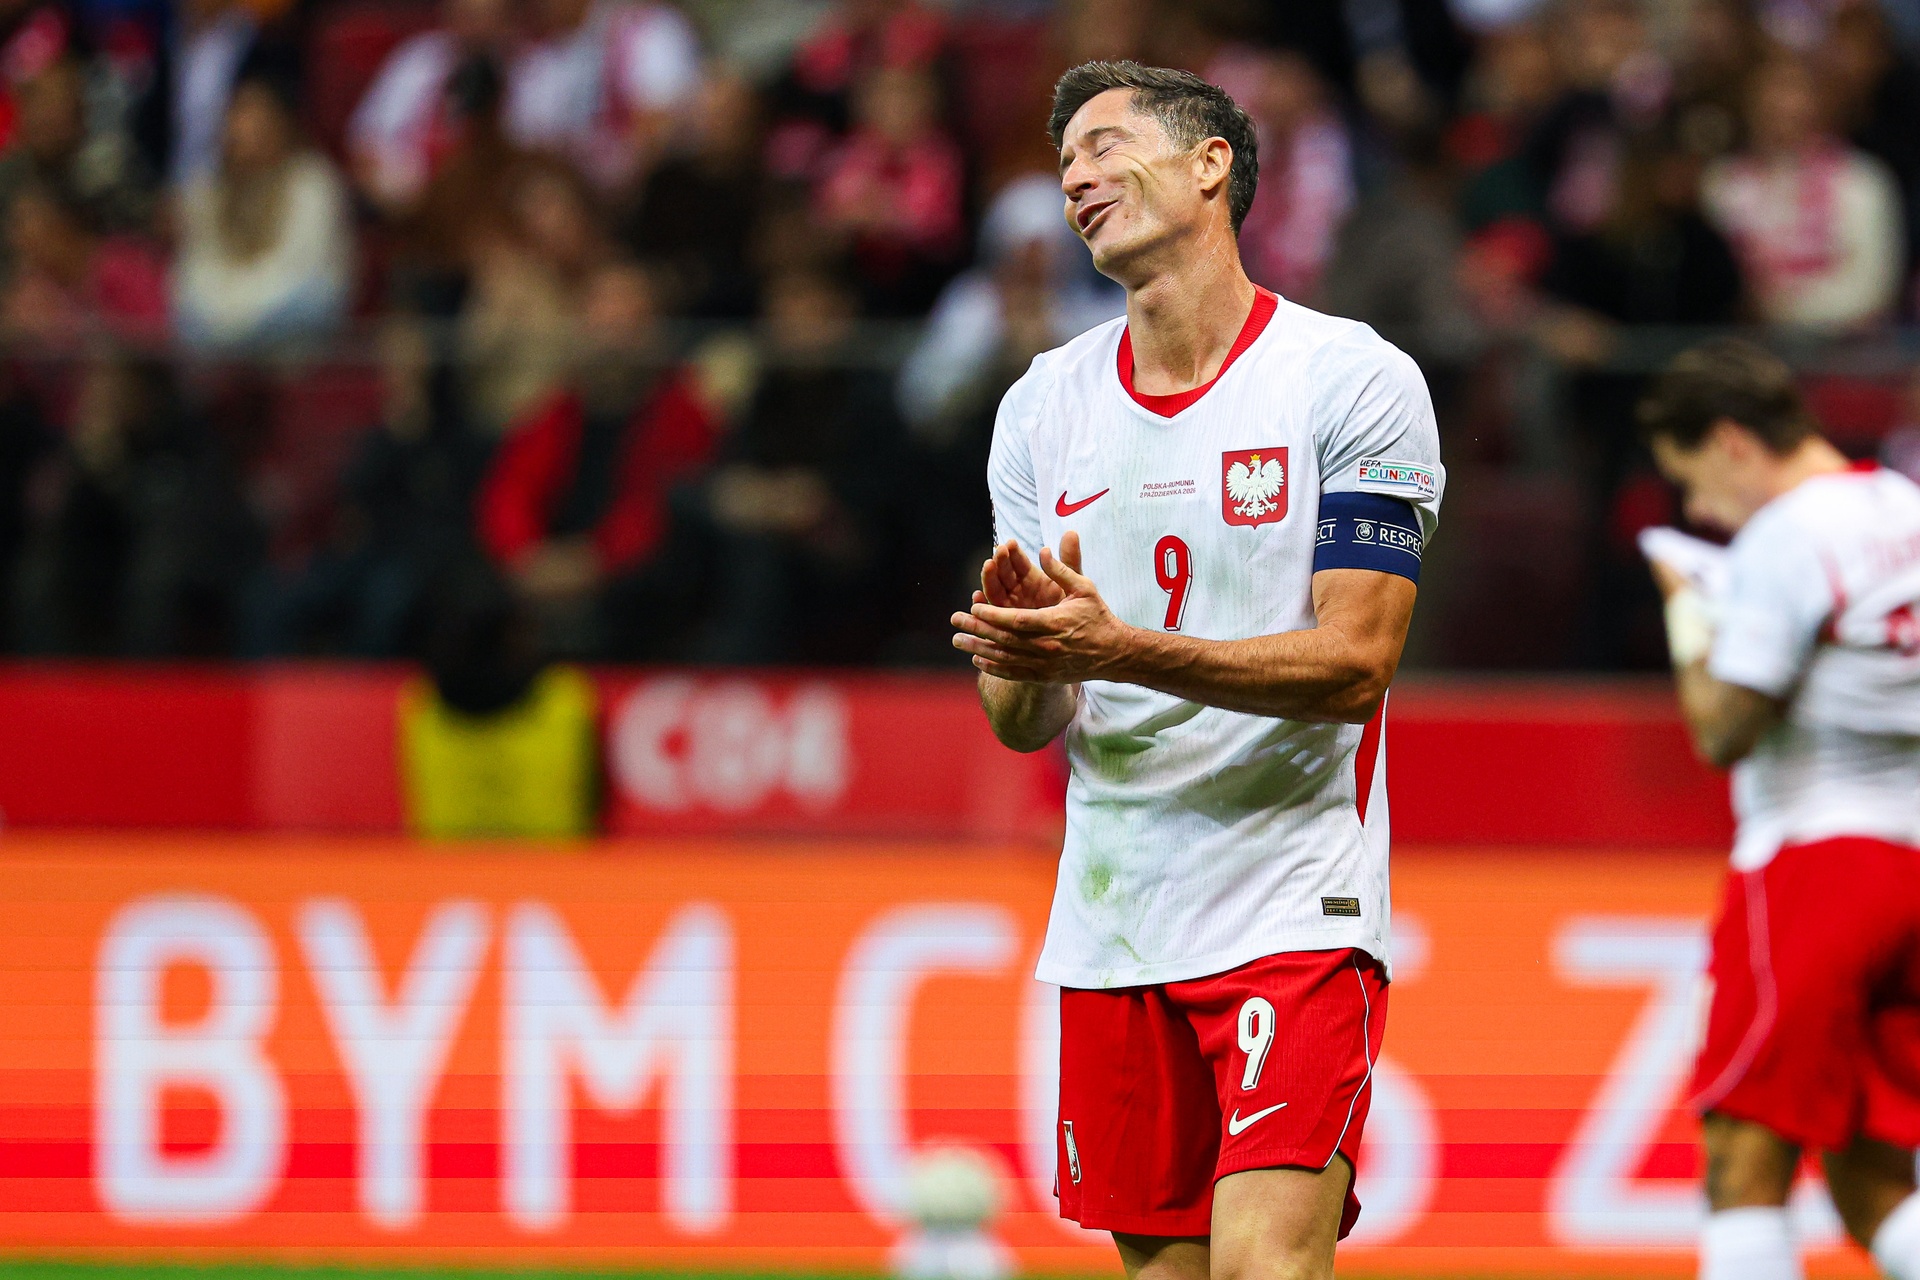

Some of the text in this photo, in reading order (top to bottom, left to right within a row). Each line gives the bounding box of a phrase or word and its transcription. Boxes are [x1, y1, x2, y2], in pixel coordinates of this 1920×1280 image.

[1154, 534, 1192, 631] 9
[95, 894, 735, 1231] BYM
[1237, 996, 1276, 1091] 9
